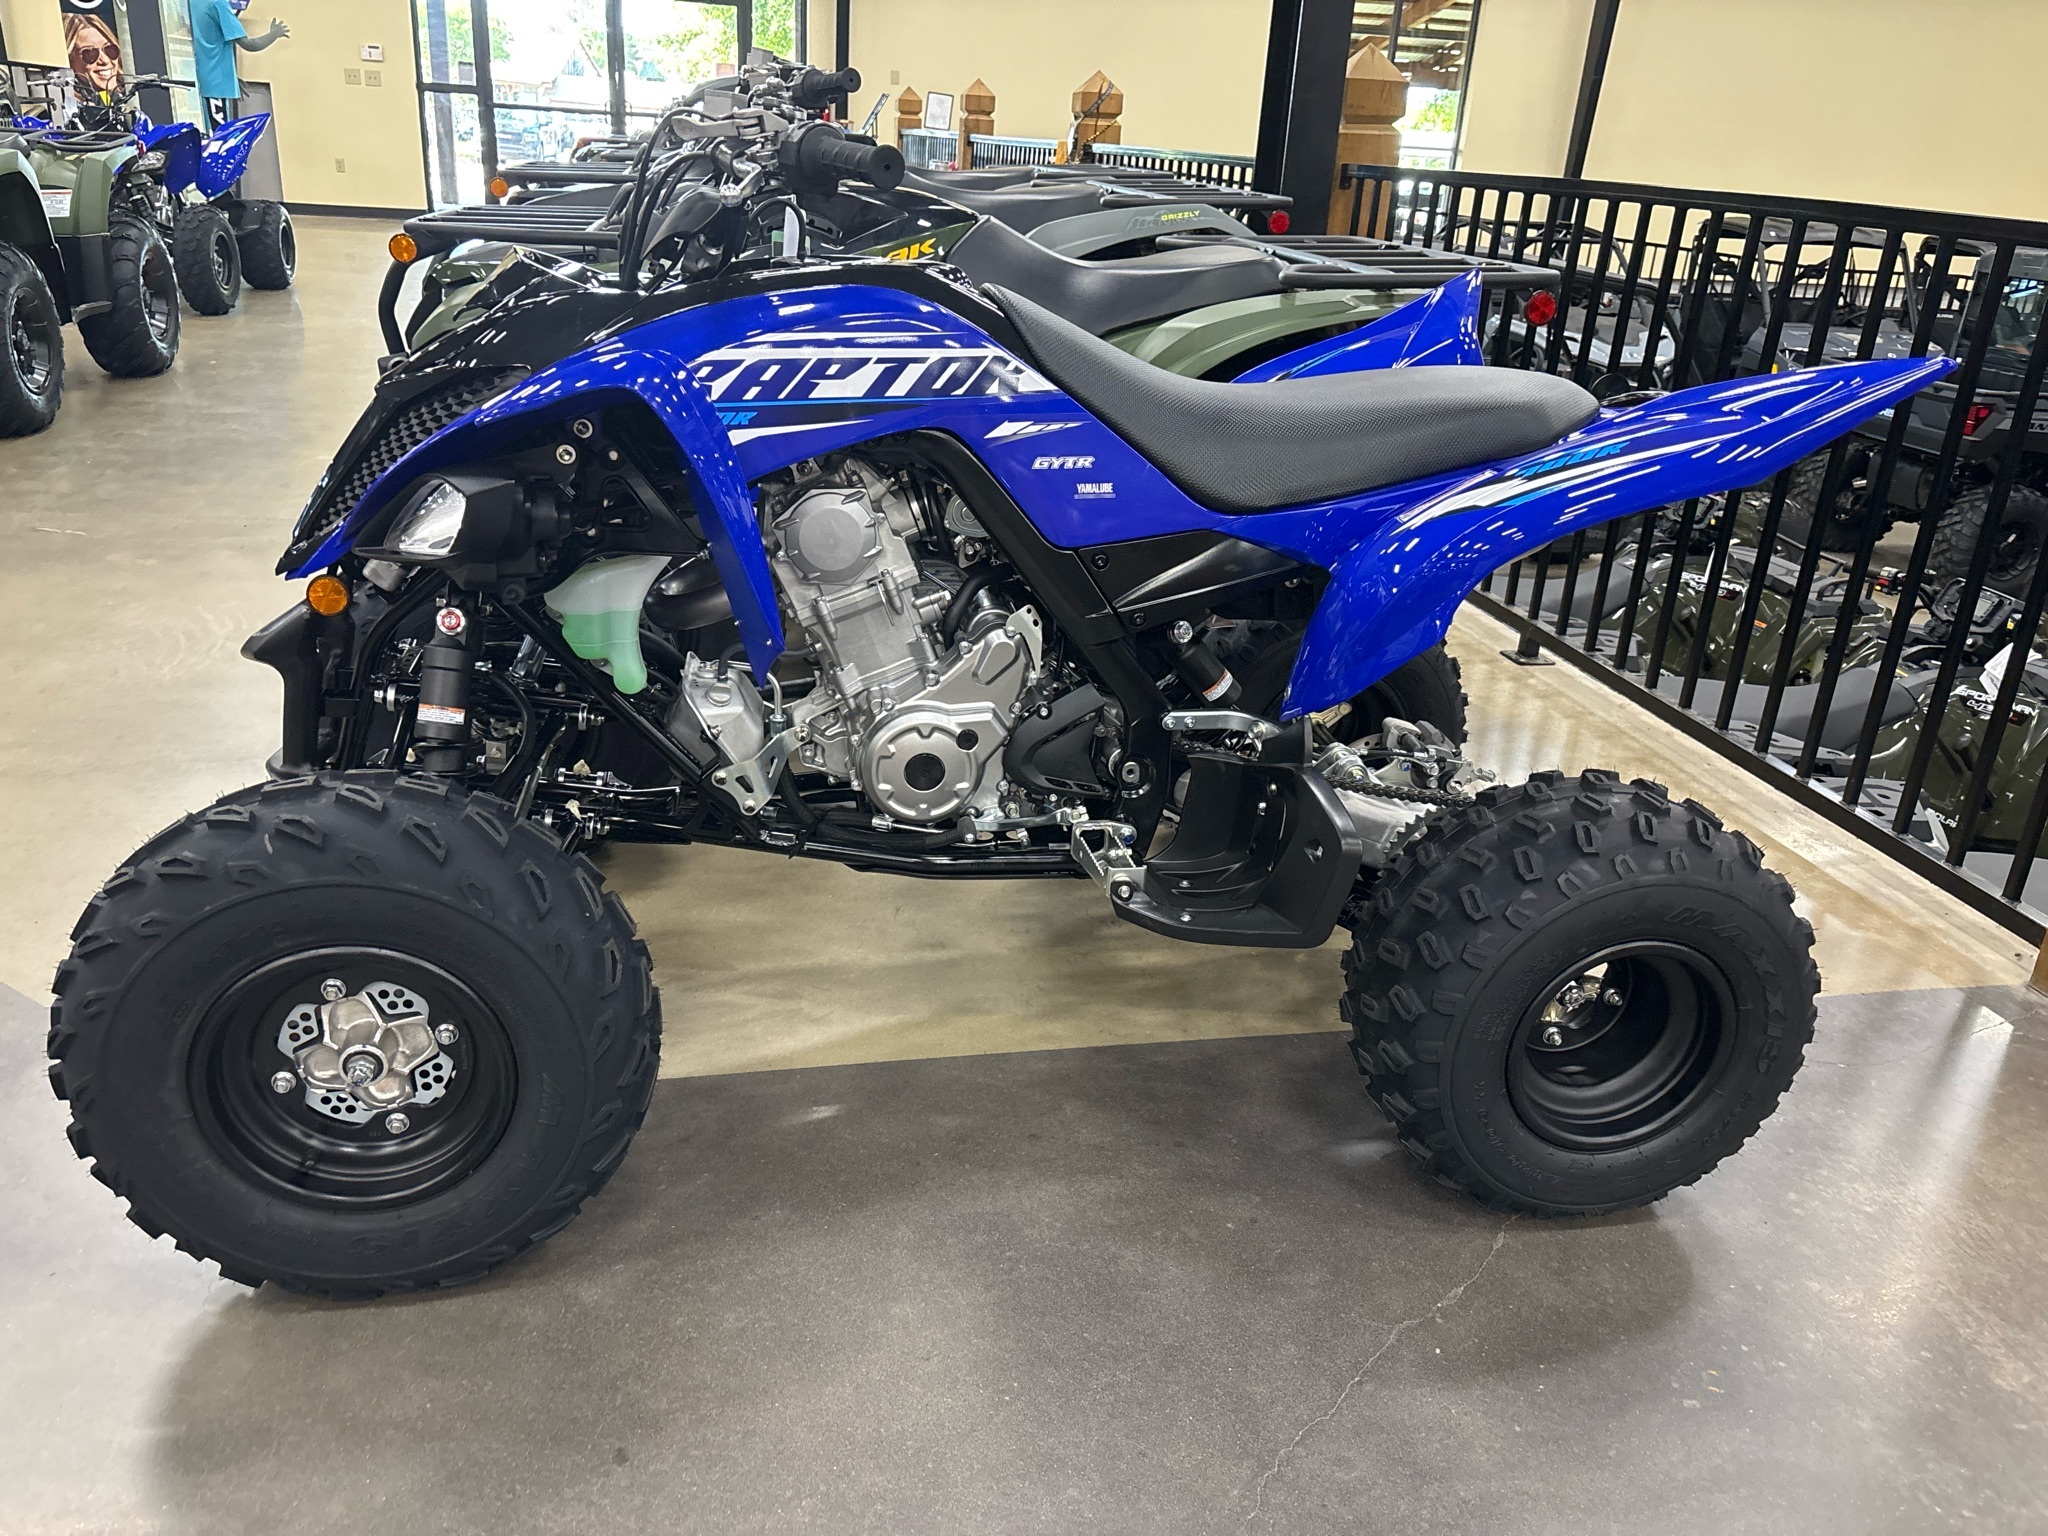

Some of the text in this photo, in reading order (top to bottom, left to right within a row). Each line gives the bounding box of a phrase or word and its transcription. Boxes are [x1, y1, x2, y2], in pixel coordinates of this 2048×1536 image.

[1161, 210, 1200, 221] GRIZZLY
[697, 353, 1026, 399] RAPTOR
[1031, 456, 1096, 470] GYTR
[1514, 441, 1631, 478] 700R
[1076, 482, 1114, 494] YAMALUBE
